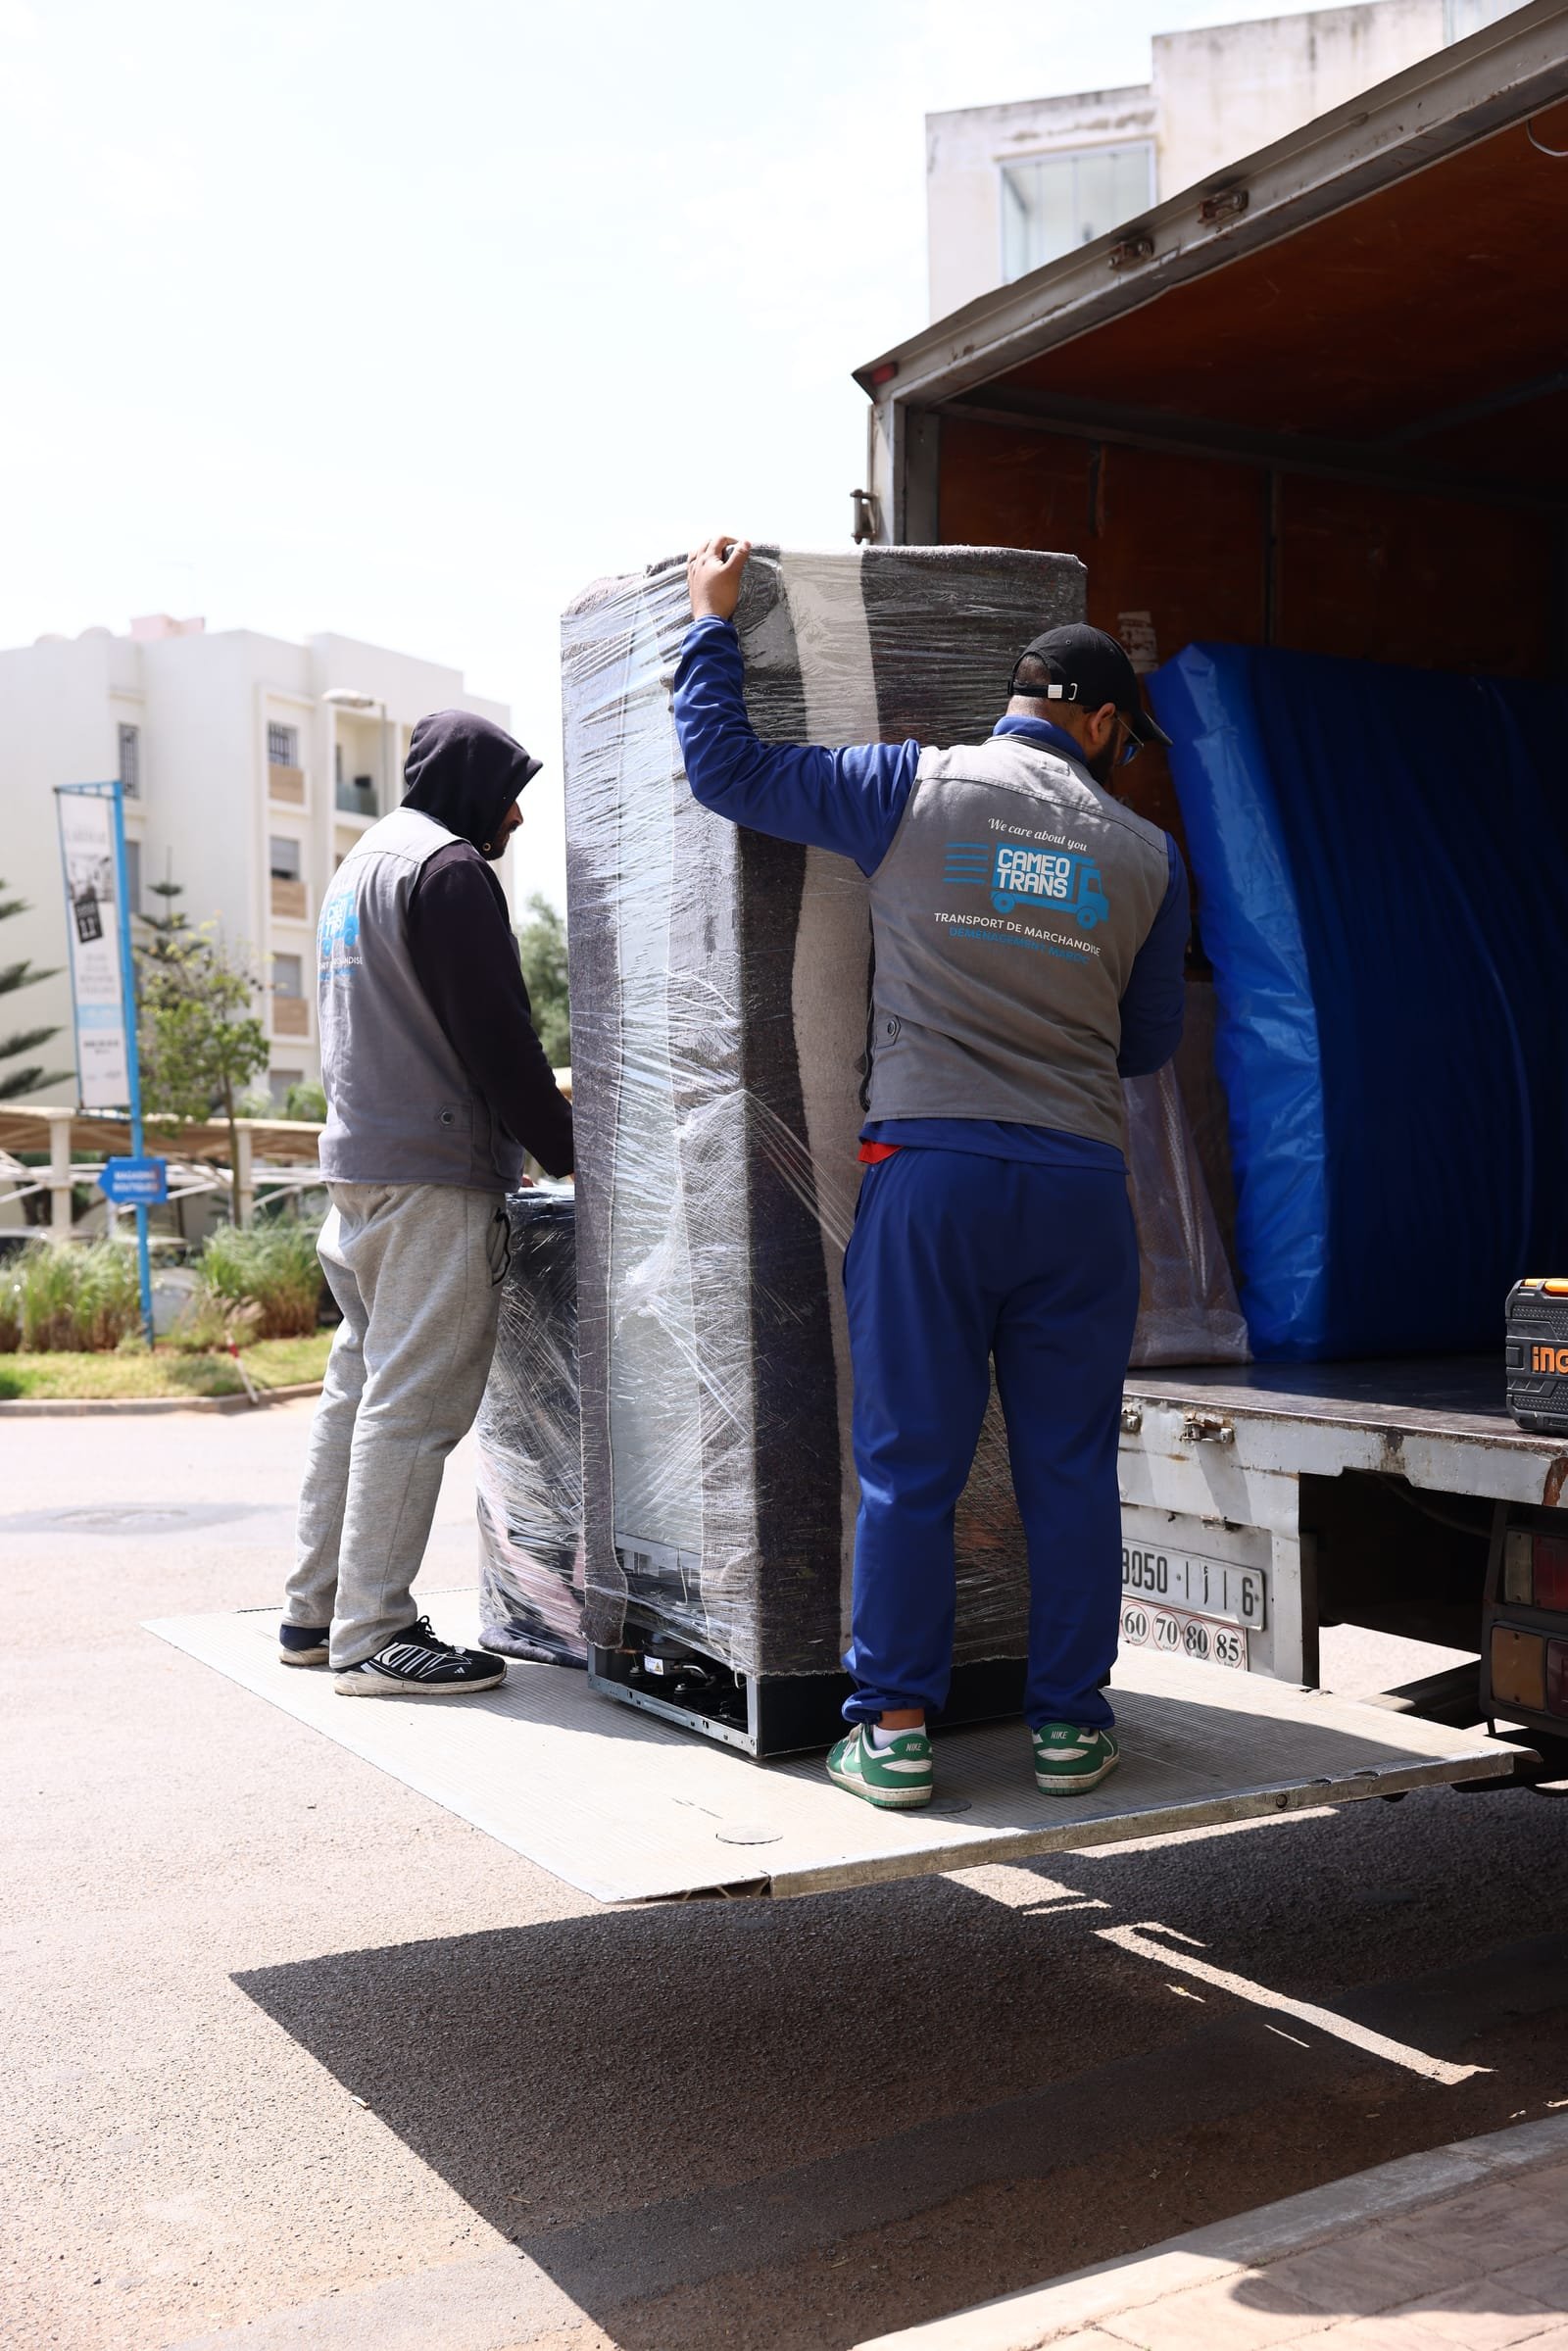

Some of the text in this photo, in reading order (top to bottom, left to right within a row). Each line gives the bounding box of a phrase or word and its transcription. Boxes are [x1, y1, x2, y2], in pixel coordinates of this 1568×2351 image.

[988, 817, 1088, 852] We care about you
[998, 848, 1071, 879] CAMEO
[997, 867, 1067, 899] TRANS
[934, 912, 1004, 929] TRANSPORT
[1006, 921, 1022, 933] DE
[1242, 1577, 1253, 1617] 6
[1124, 1611, 1239, 1662] 60 70 80 85
[906, 1742, 922, 1751] NIKE
[1051, 1731, 1068, 1739] NIKE
